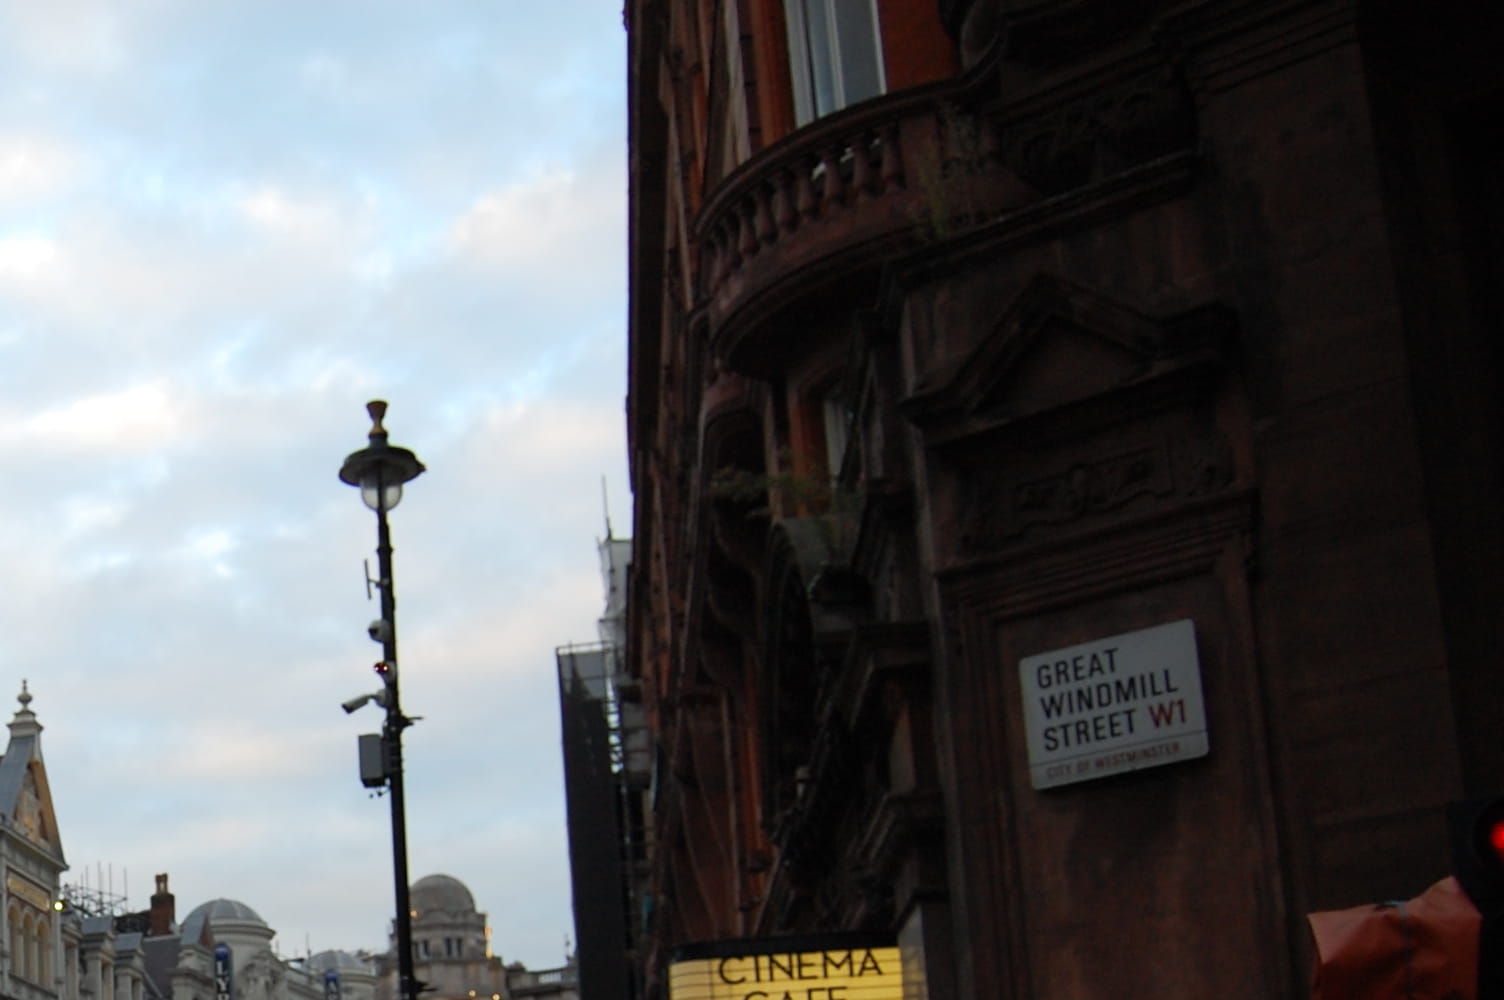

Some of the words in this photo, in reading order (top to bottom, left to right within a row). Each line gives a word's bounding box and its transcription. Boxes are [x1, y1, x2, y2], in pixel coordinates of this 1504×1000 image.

[1037, 648, 1119, 689] GREAT
[1040, 669, 1179, 720] WINDMILL
[1044, 708, 1137, 751] STREET
[1148, 699, 1187, 729] W1
[1046, 765, 1072, 780] CITY
[1077, 761, 1090, 775] OF
[1095, 742, 1180, 769] WESTMINSTER
[718, 949, 883, 985] CINEMA
